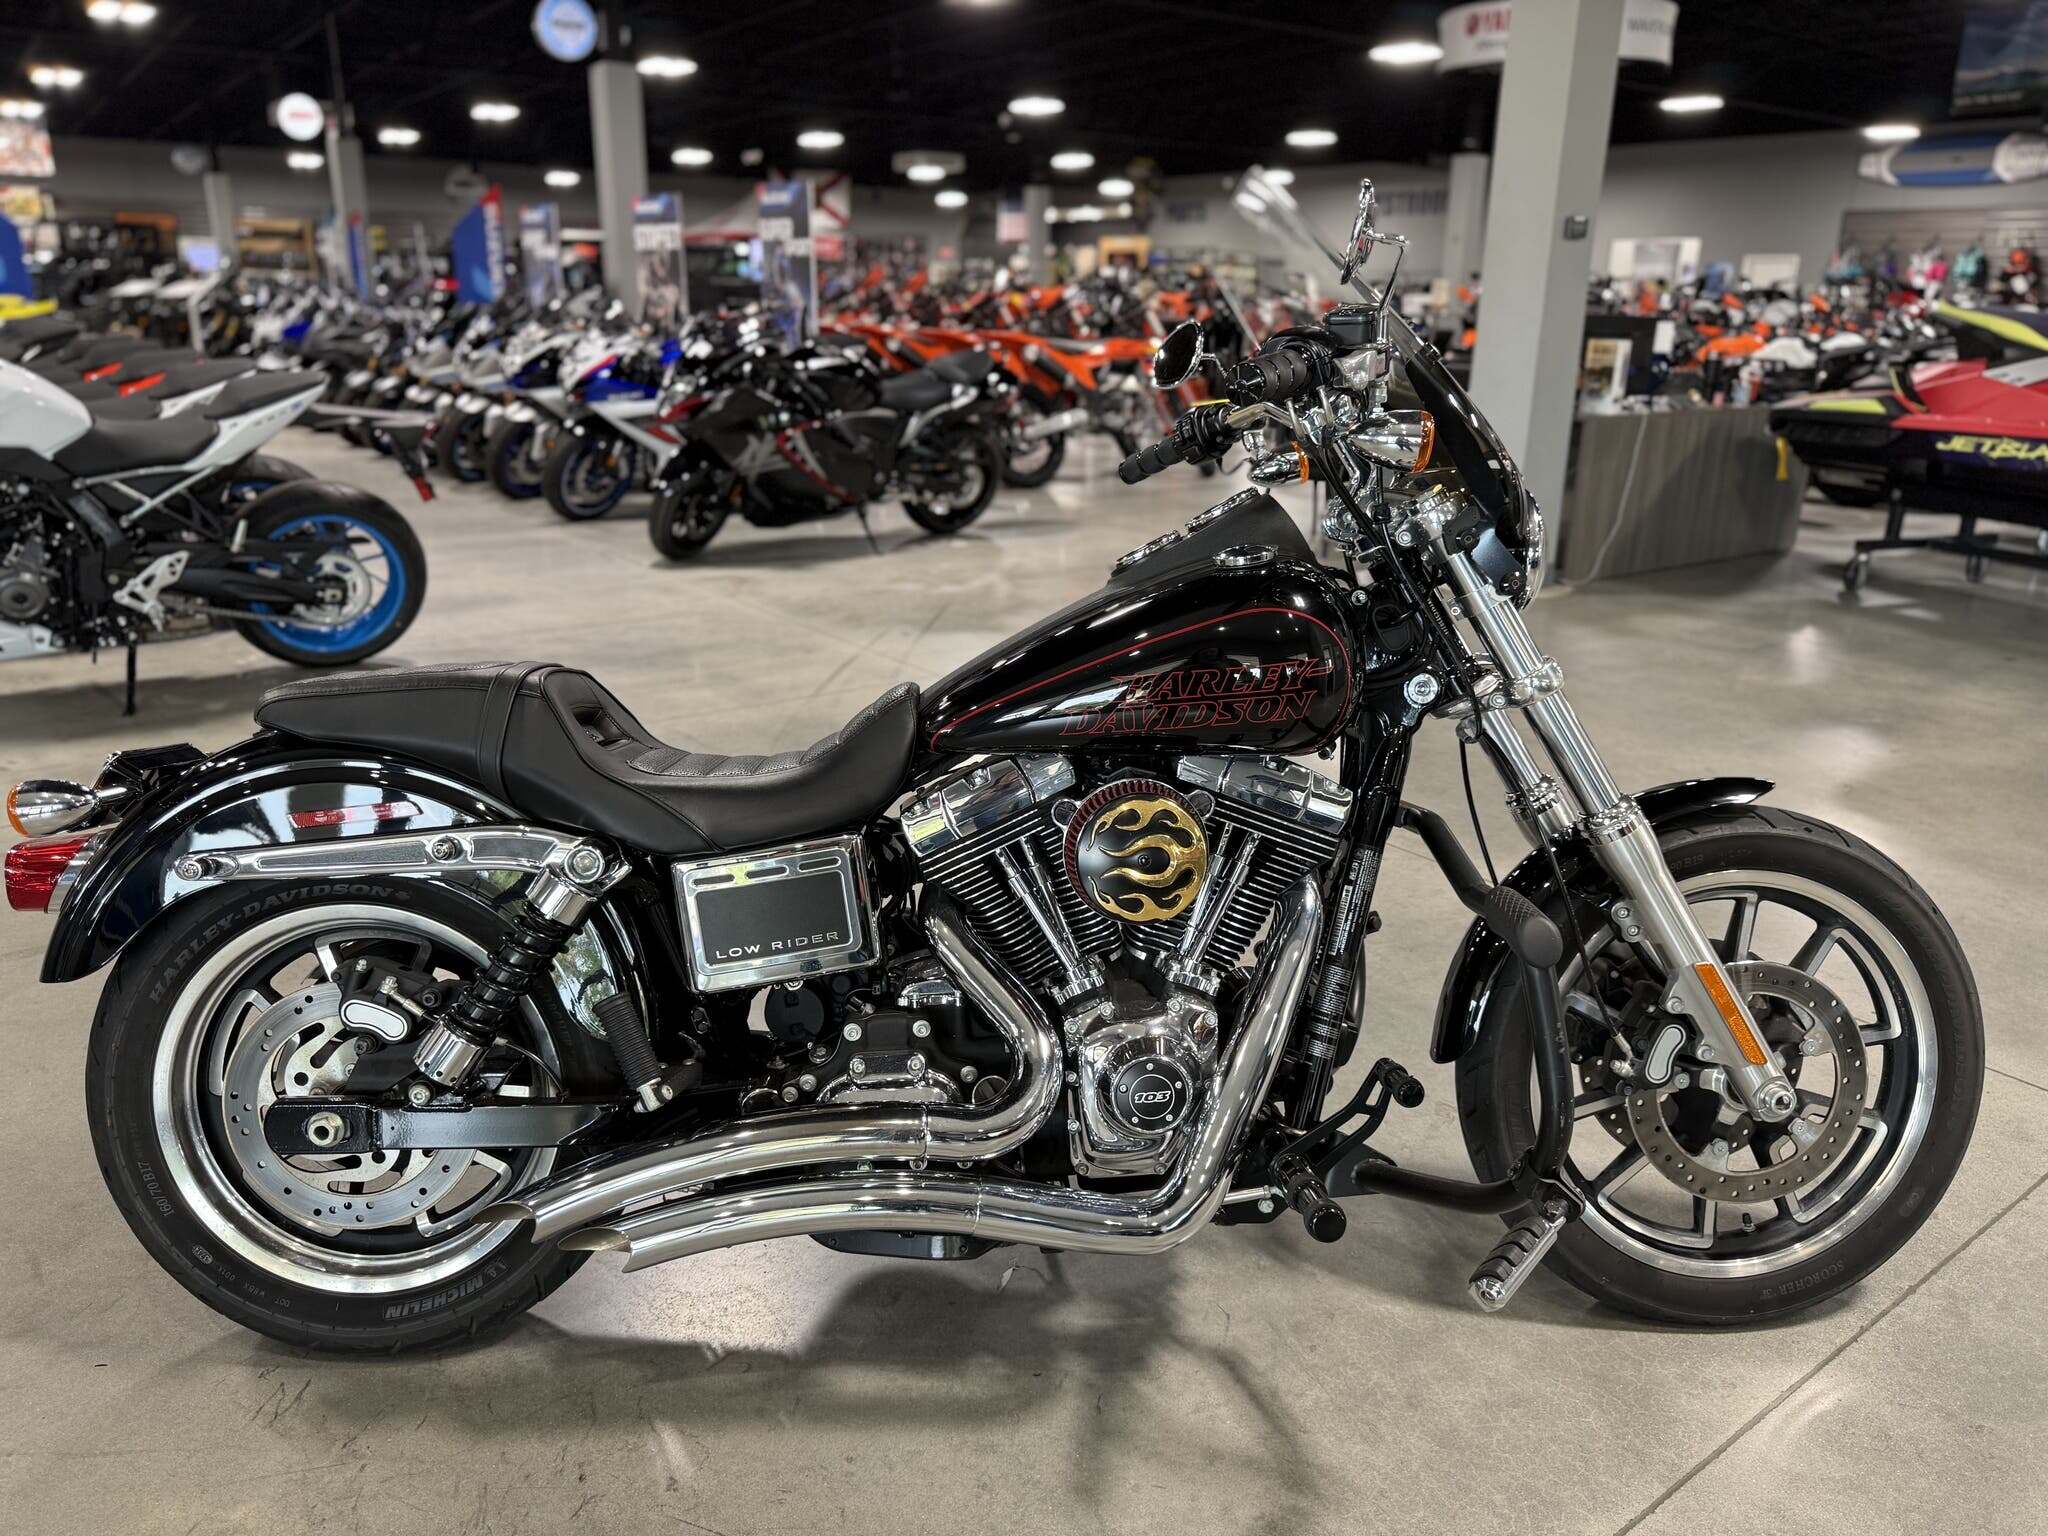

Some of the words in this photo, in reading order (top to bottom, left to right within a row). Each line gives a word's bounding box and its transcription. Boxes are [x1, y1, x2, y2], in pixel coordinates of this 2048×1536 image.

[1111, 658, 1334, 701] HARLEY
[1059, 690, 1317, 736] DAVIDSON
[716, 944, 761, 959] LOW
[771, 931, 839, 950] RIDER
[1134, 1091, 1171, 1103] 103
[384, 1275, 484, 1319] MICHELIN
[1779, 1261, 1845, 1297] SCORCHER
